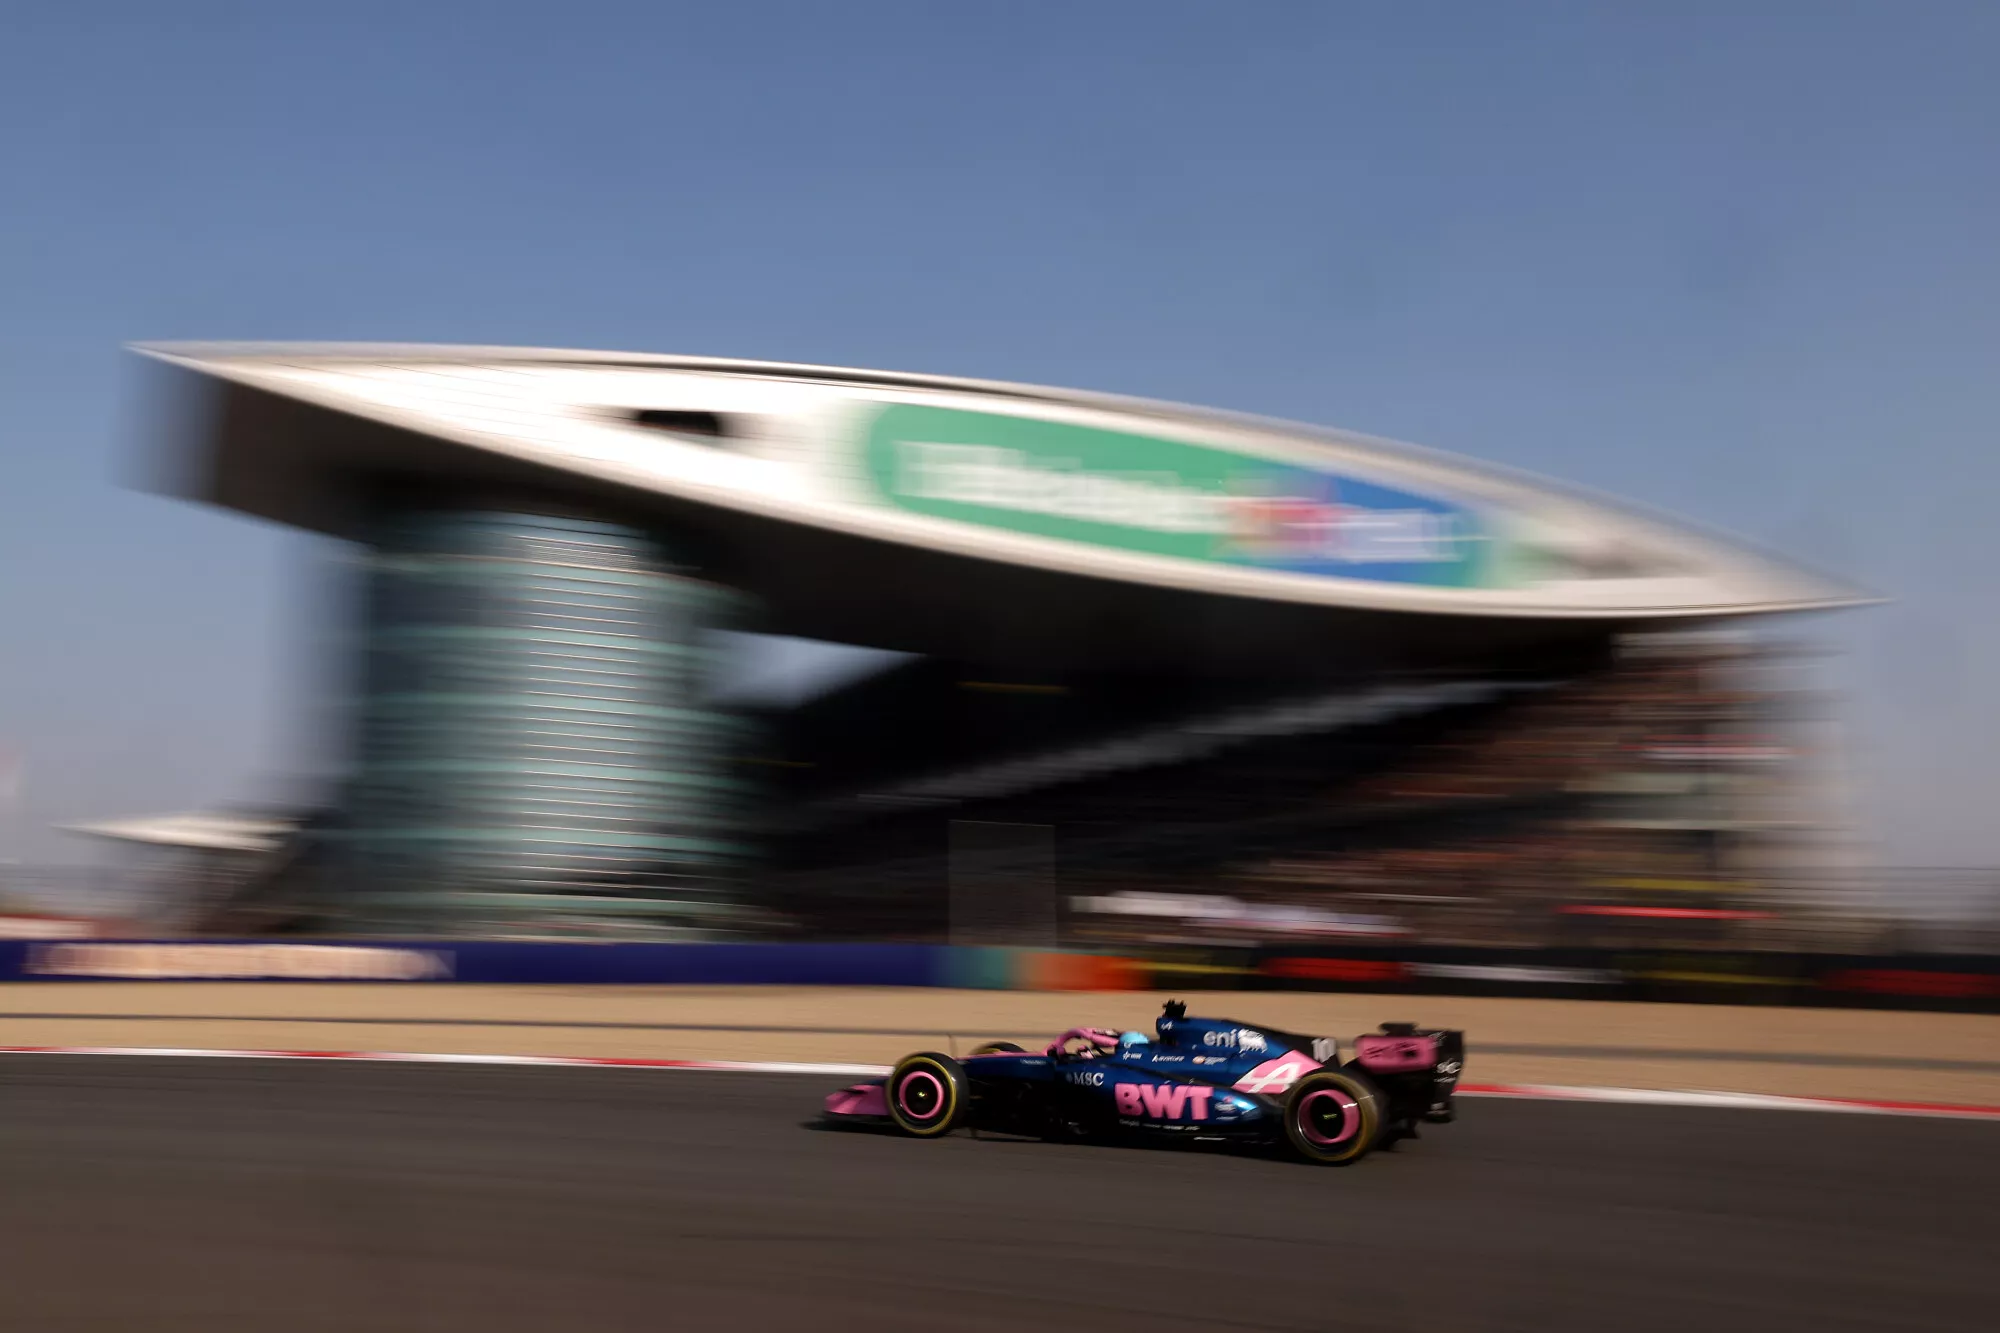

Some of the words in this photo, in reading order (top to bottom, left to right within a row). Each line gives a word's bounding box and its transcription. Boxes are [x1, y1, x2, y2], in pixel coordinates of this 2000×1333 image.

[1203, 1029, 1237, 1048] eni
[1312, 1038, 1337, 1063] 10
[1074, 1072, 1105, 1087] MSC
[1114, 1083, 1214, 1120] BWT
